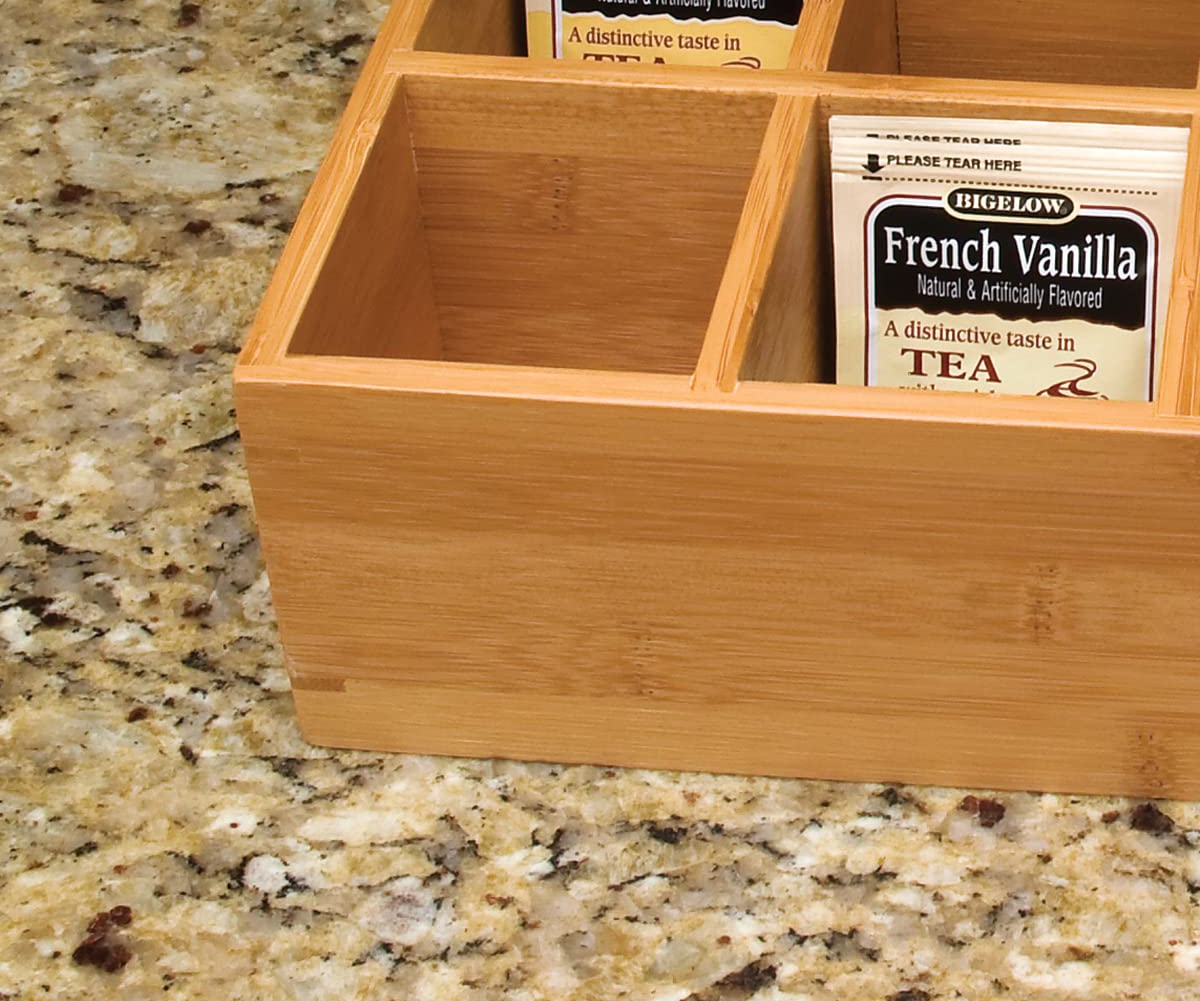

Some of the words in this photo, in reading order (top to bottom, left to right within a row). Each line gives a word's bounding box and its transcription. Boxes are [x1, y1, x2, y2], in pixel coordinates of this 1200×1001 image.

[568, 26, 582, 43] A
[586, 27, 673, 48] distinctive
[678, 33, 720, 50] taste
[724, 33, 741, 51] in
[887, 154, 941, 167] PLEASE
[944, 157, 981, 170] TEAR
[984, 159, 1022, 172] HERE
[954, 192, 1066, 214] BIGELOW
[883, 226, 1002, 274] French
[1012, 233, 1138, 281] Vanilla
[917, 274, 962, 299] Natural
[966, 281, 976, 300] &
[981, 278, 1044, 310] Artificially
[1049, 284, 1103, 309] Flavored
[884, 320, 899, 337] A
[904, 321, 1001, 346] distinctive
[1006, 330, 1052, 350] taste
[1057, 332, 1075, 351] in
[900, 347, 1002, 383] TEA
